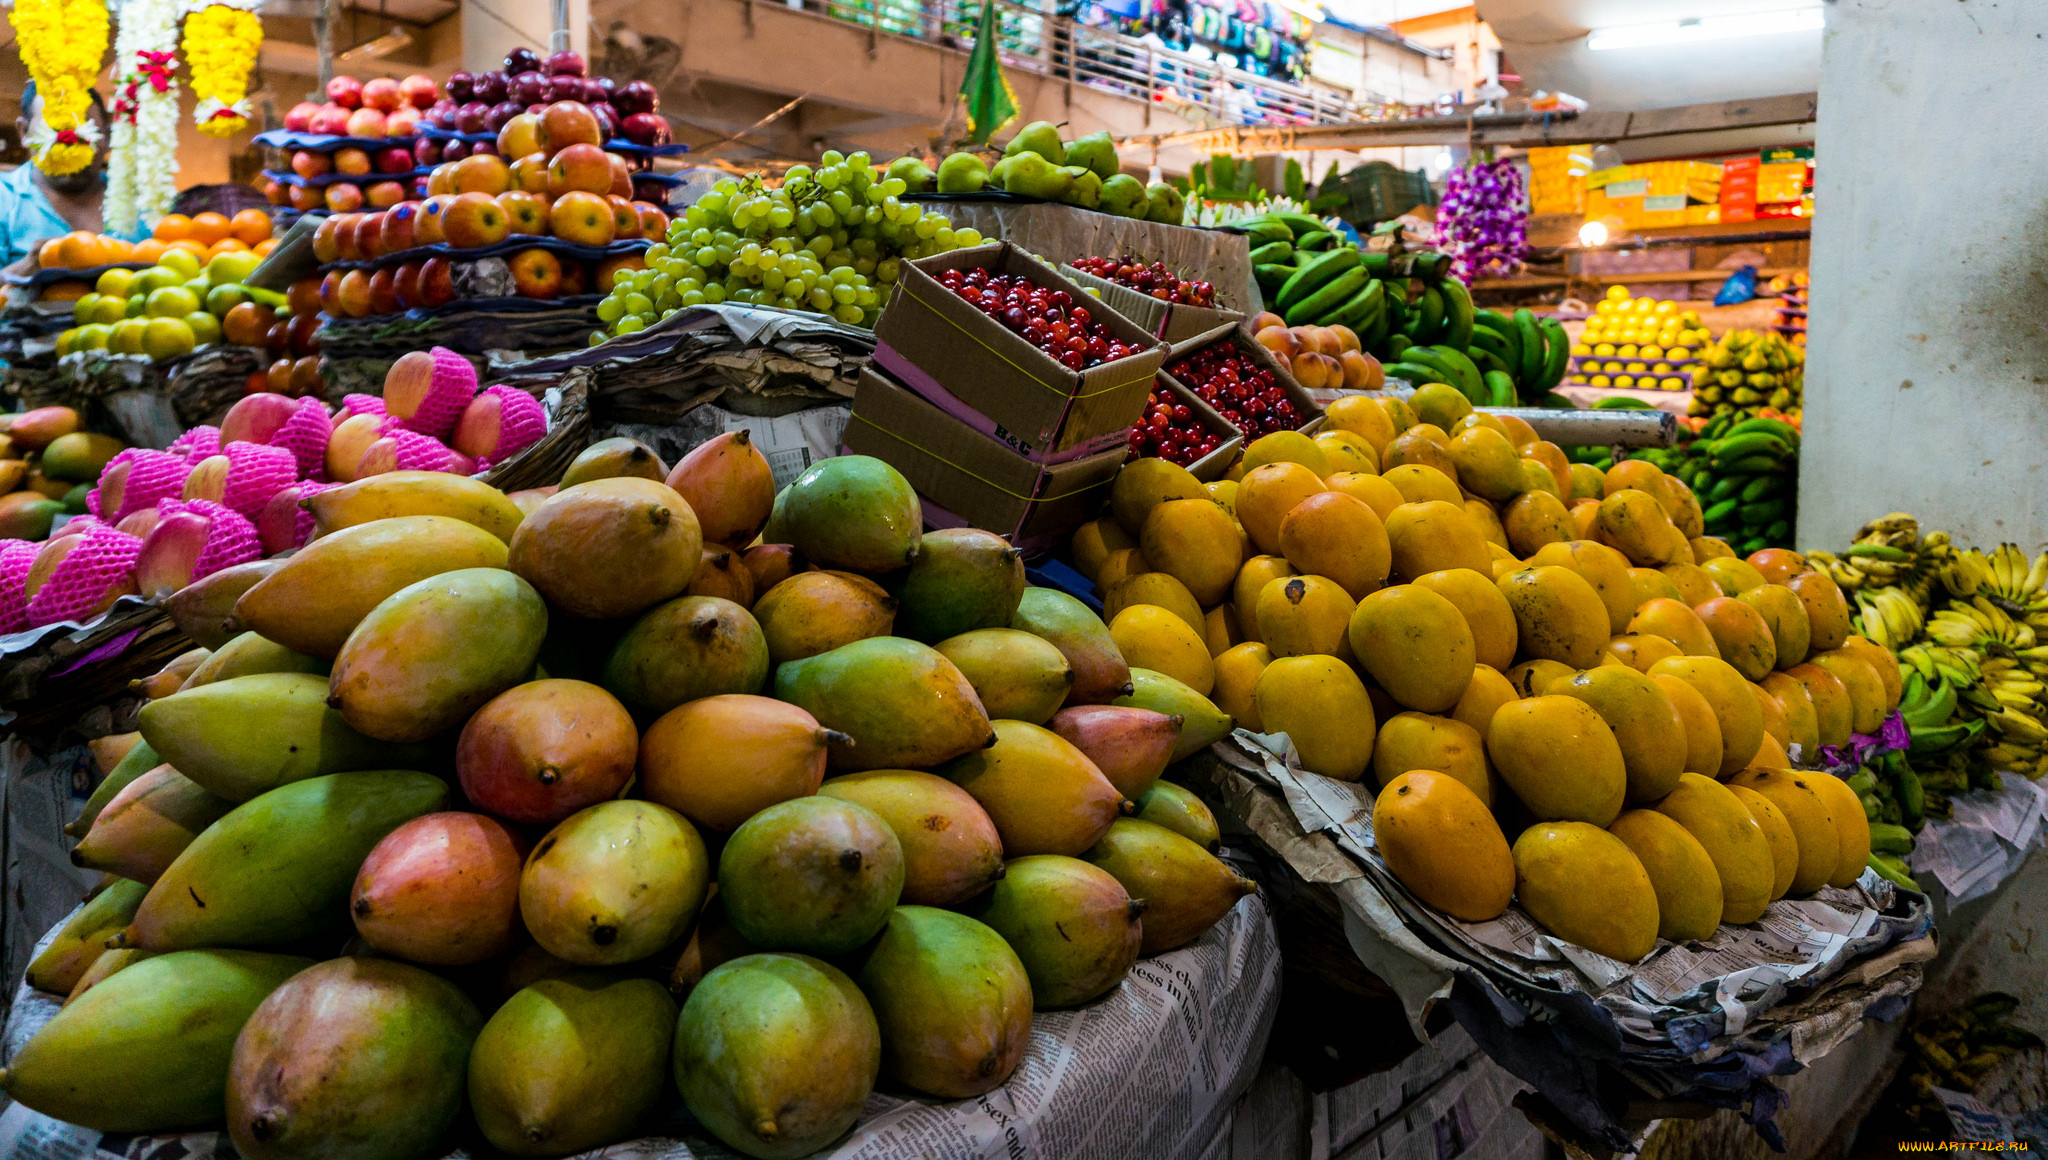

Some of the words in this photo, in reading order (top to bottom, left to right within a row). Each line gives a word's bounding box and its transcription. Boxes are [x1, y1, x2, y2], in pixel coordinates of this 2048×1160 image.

[994, 423, 1033, 456] B&C
[1166, 979, 1181, 1001] in
[1181, 996, 1197, 1045] India
[1175, 969, 1200, 1013] chain
